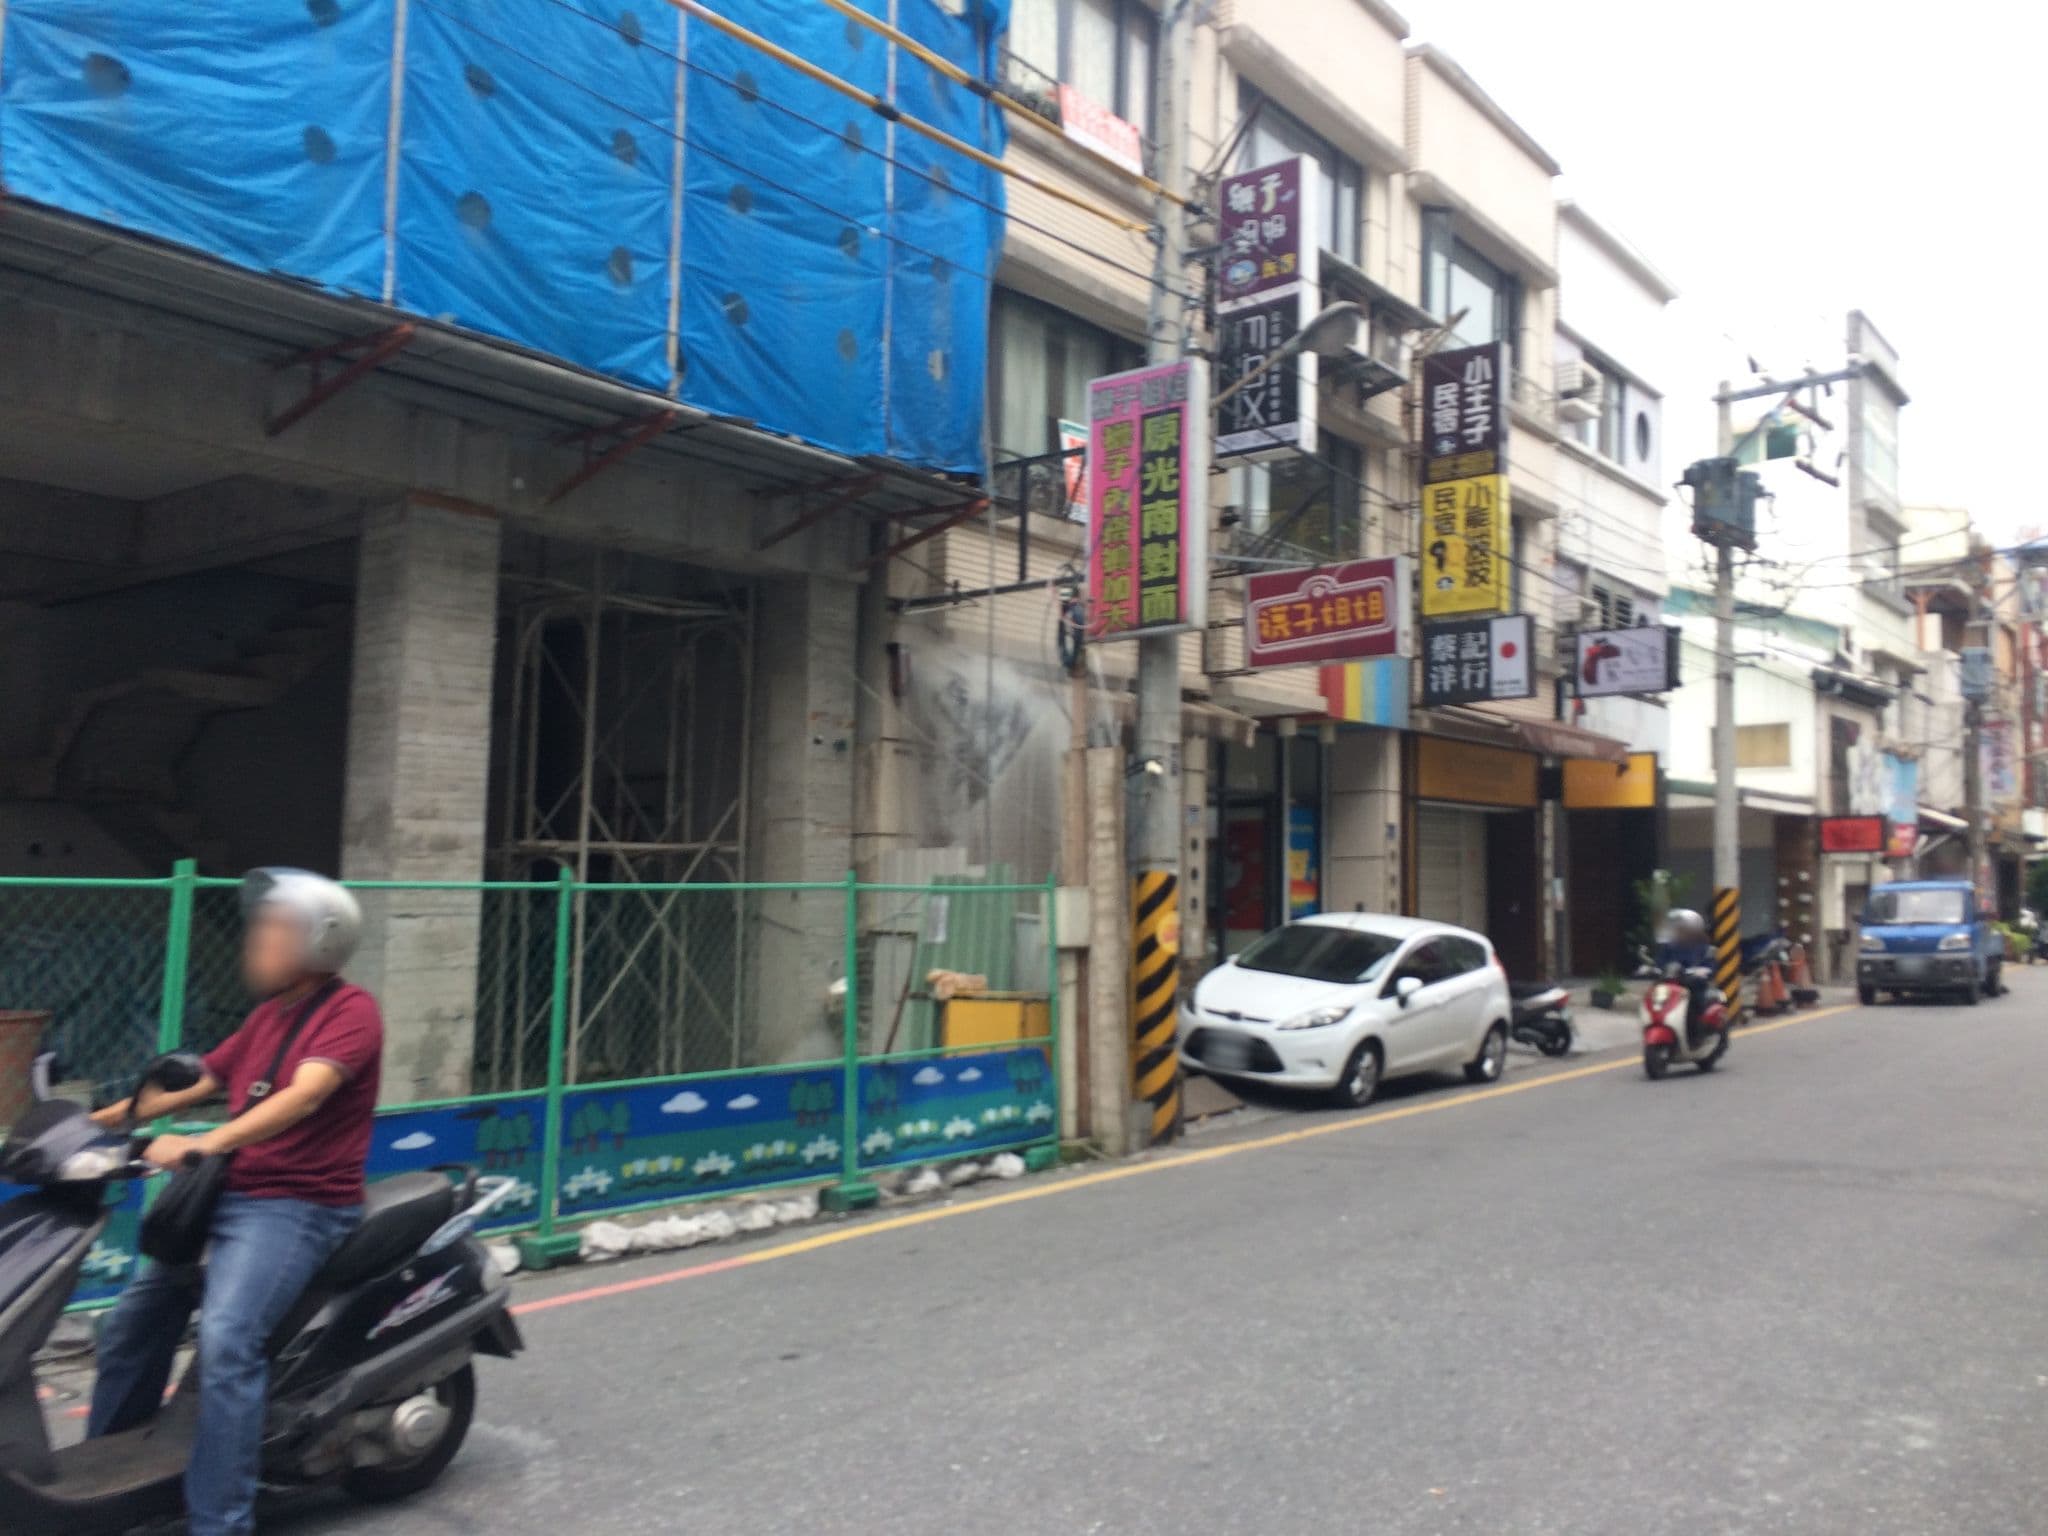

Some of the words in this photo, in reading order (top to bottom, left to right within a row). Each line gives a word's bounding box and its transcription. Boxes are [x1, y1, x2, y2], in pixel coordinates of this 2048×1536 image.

[1463, 354, 1492, 445] 小王子
[1141, 412, 1180, 623] 原光南對面
